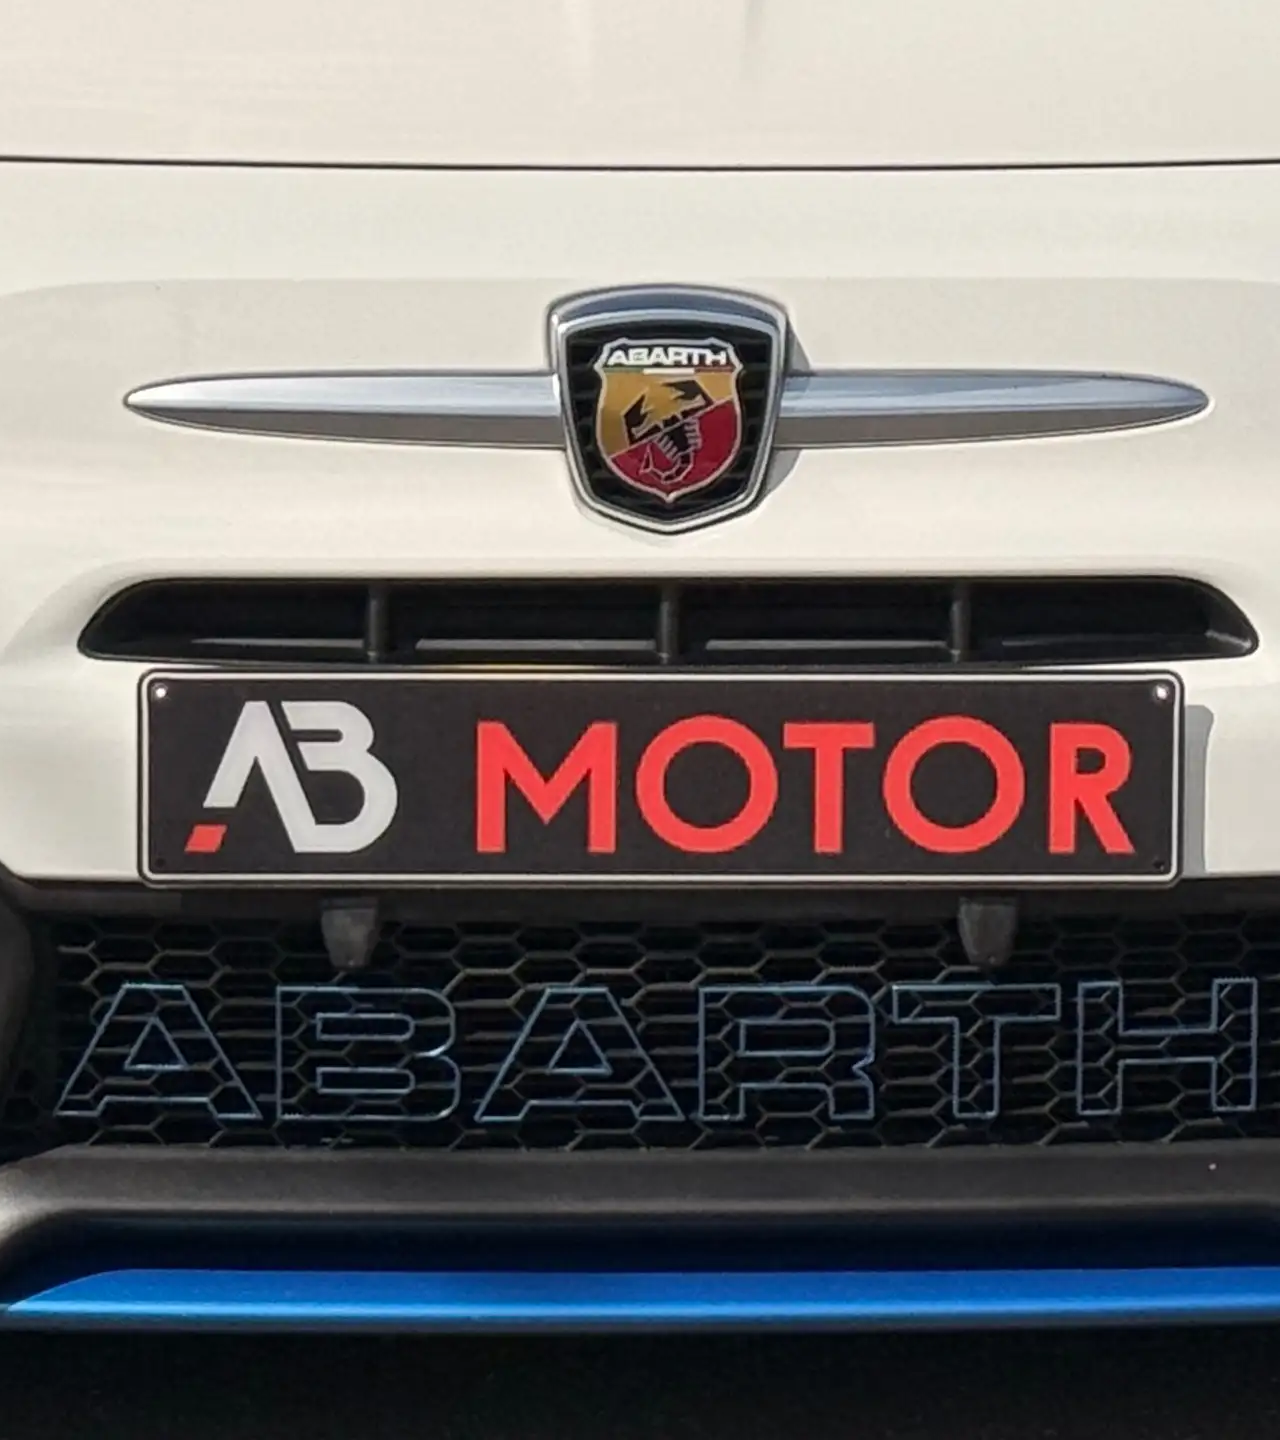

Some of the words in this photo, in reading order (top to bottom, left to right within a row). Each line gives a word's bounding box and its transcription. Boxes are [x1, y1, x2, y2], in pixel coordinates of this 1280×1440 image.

[608, 346, 727, 366] ABARTH
[476, 715, 1135, 855] MOTOR
[53, 977, 1259, 1122] ABARTH
